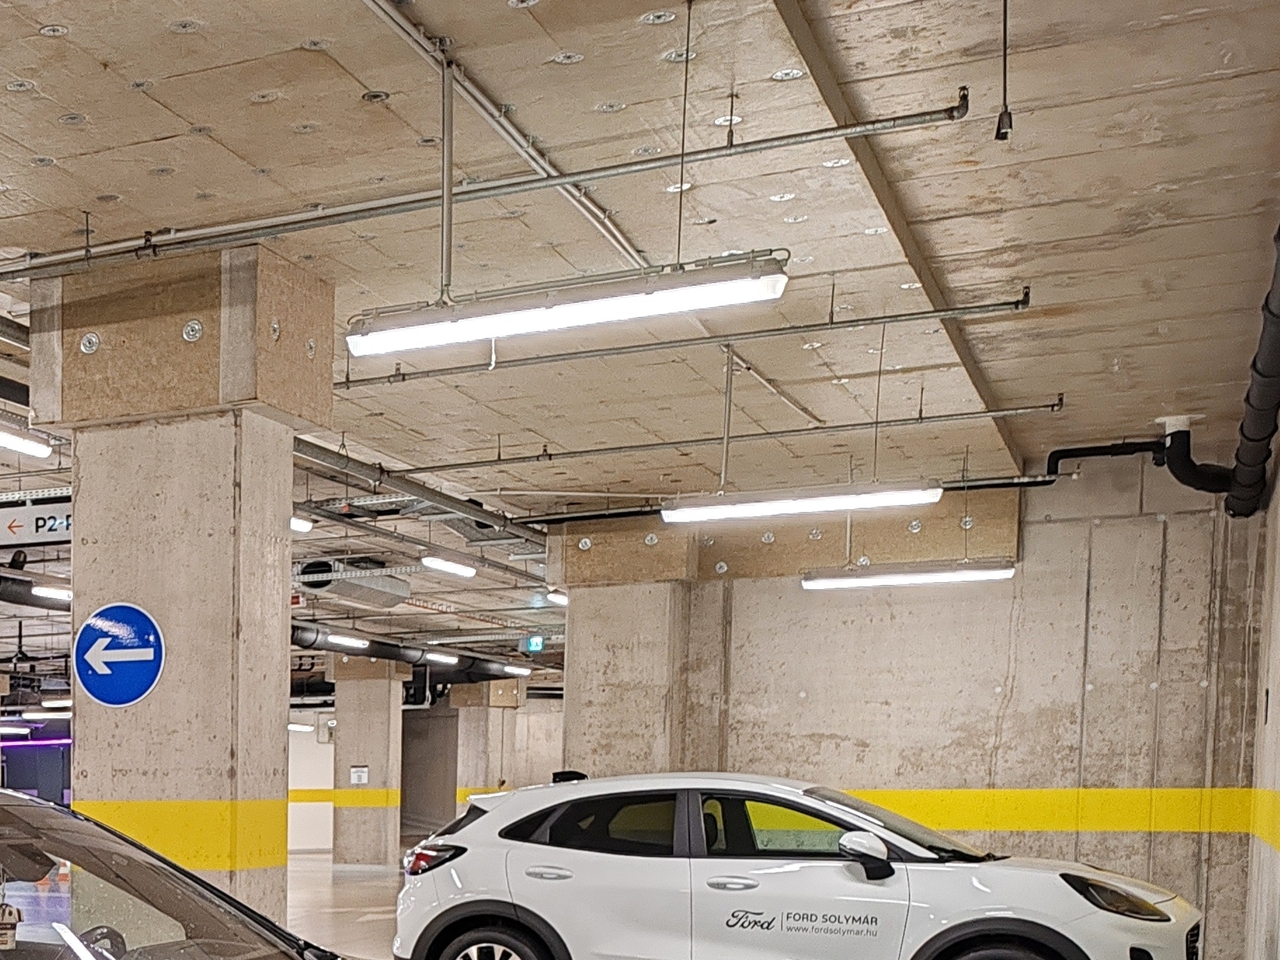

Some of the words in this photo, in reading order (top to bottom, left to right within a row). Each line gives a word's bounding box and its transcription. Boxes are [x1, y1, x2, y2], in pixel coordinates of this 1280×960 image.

[725, 909, 777, 931] Ford
[786, 912, 818, 923] FORD
[821, 912, 878, 926] SOLYMÁR
[786, 924, 878, 937] www.fordsolymar.hu
